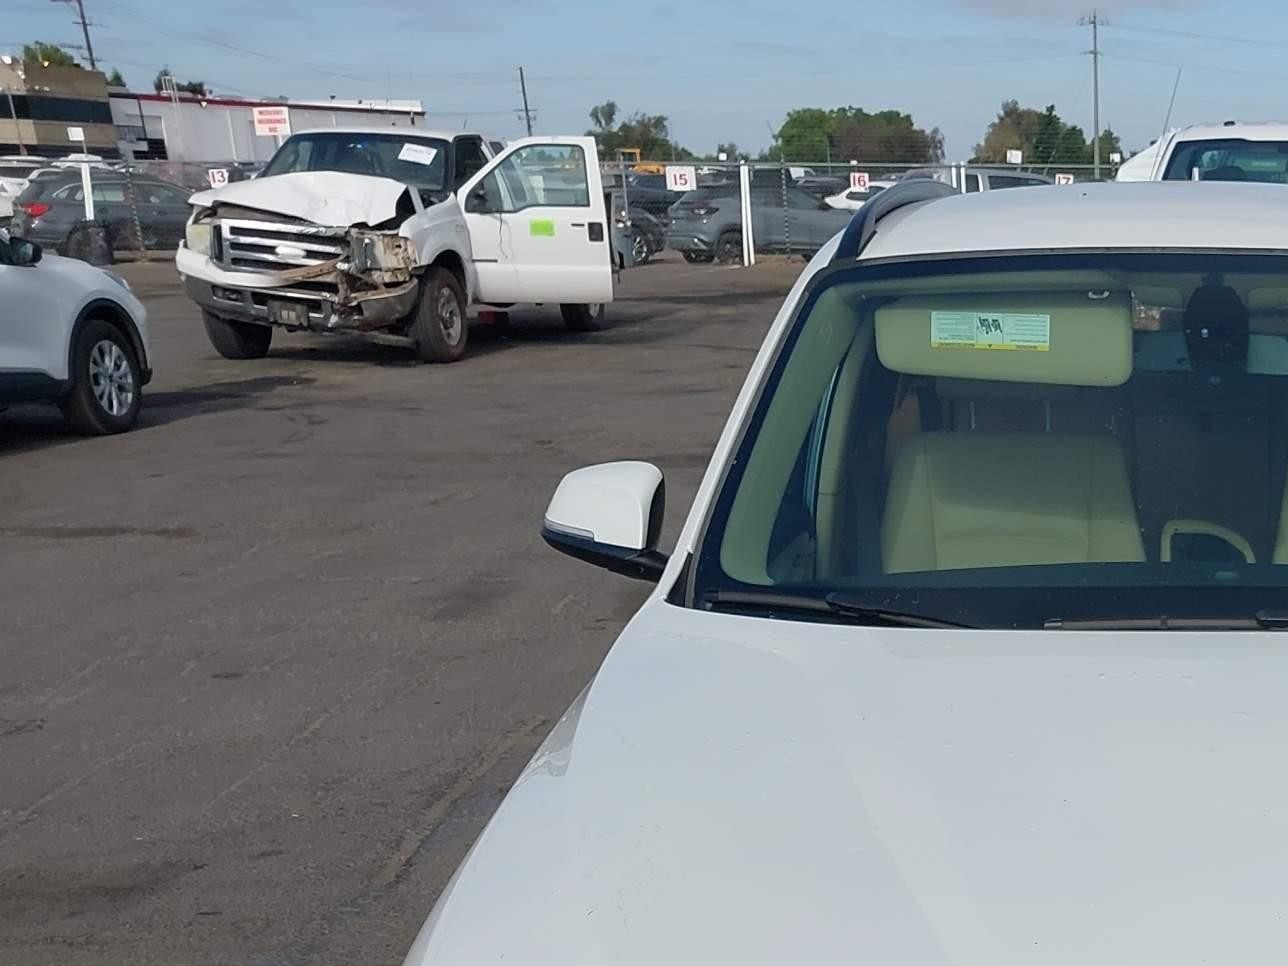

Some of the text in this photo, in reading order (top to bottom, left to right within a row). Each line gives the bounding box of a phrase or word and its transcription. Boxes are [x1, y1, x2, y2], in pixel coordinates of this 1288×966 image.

[210, 170, 226, 183] 13
[673, 173, 688, 186] 15
[853, 175, 866, 187] 16
